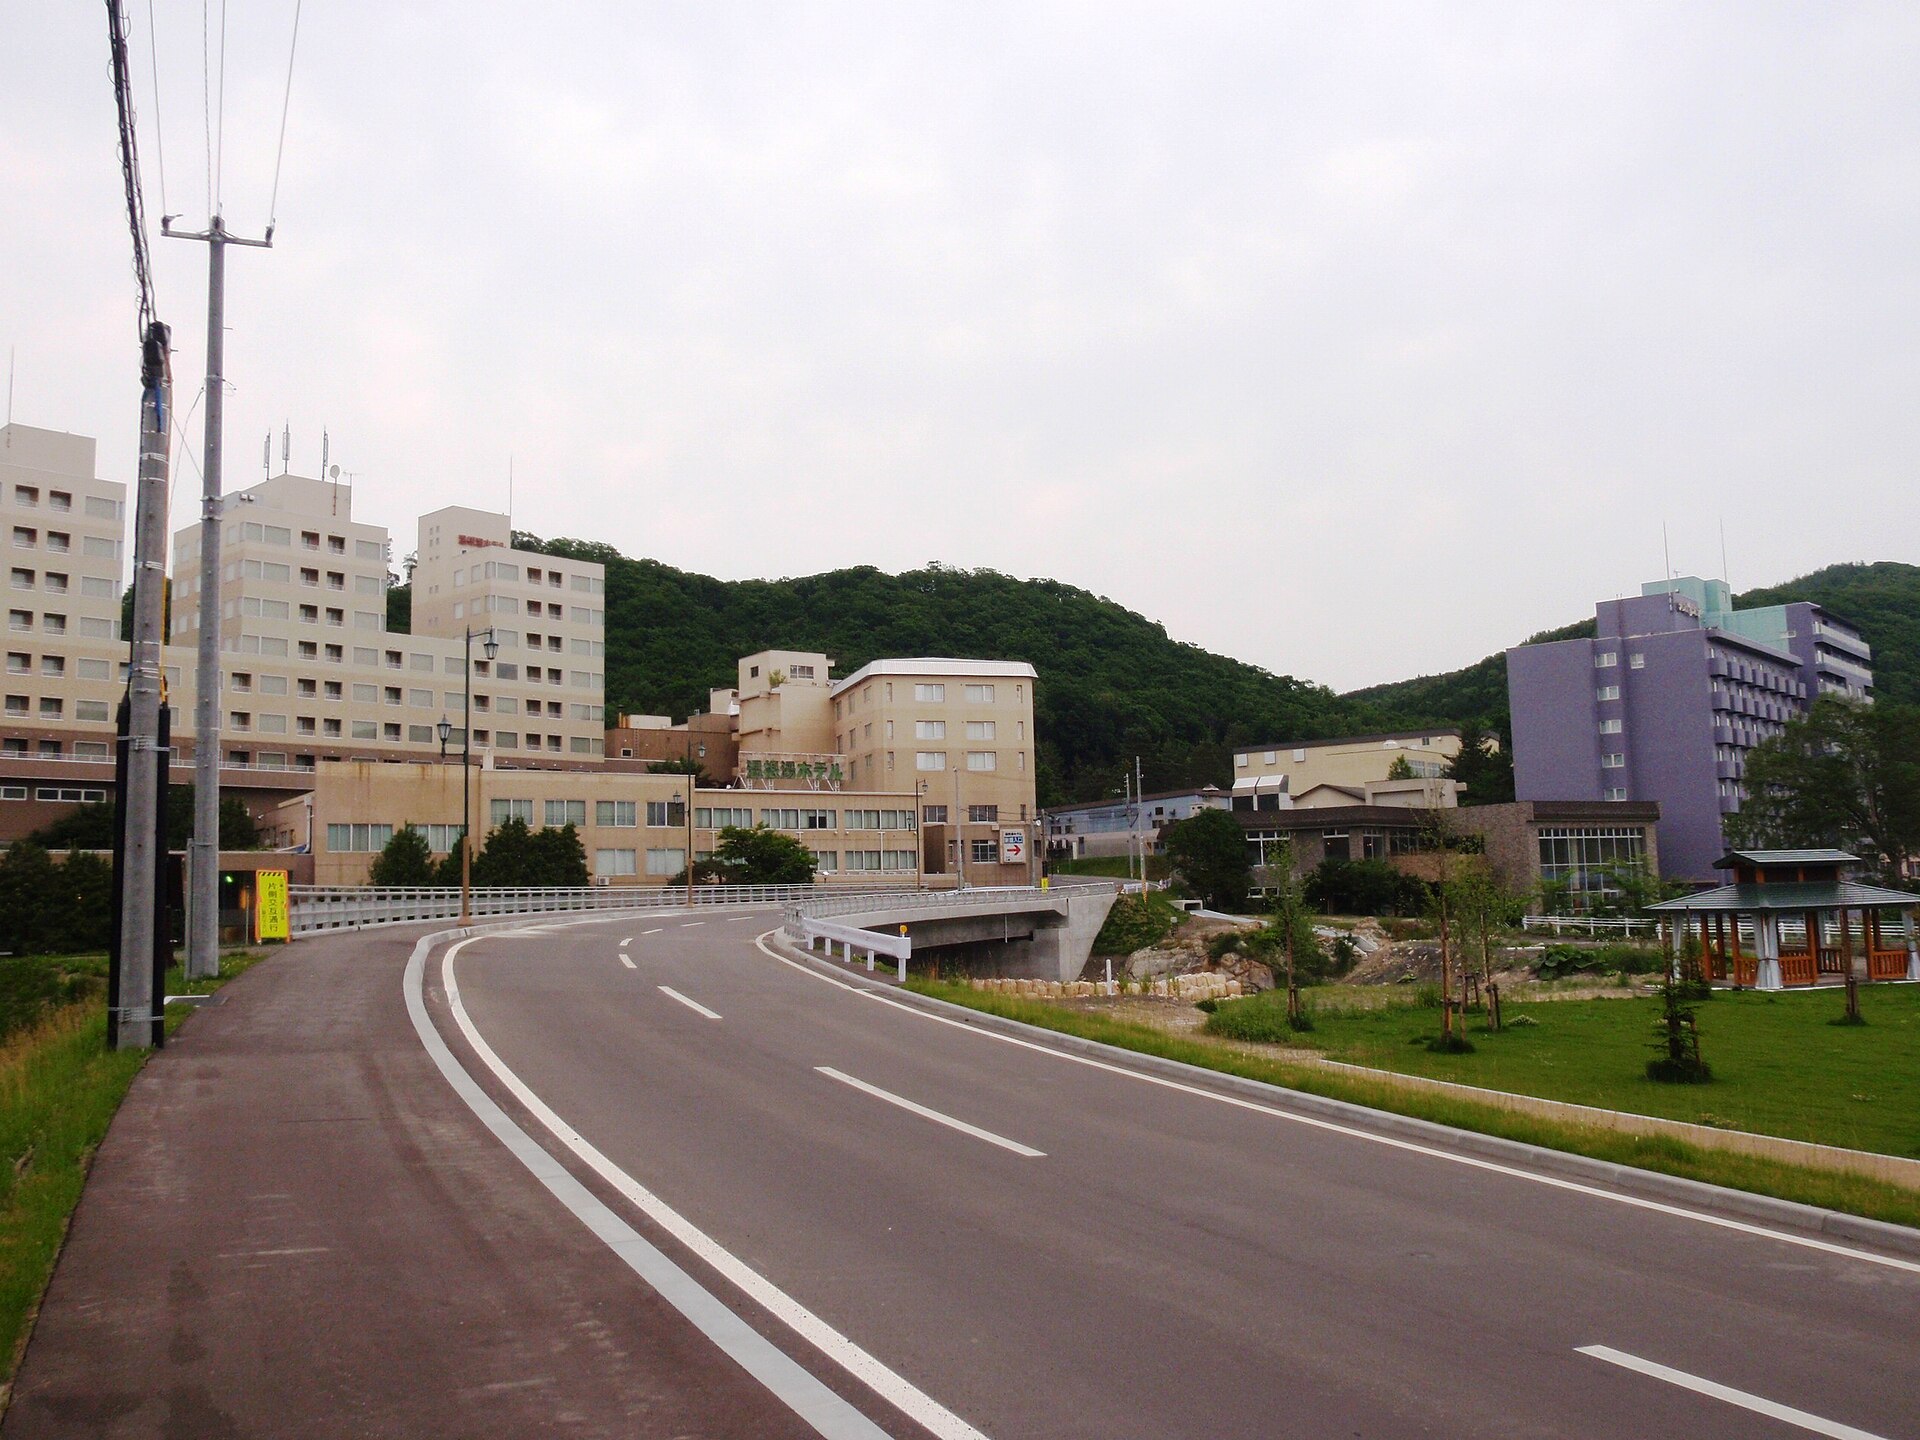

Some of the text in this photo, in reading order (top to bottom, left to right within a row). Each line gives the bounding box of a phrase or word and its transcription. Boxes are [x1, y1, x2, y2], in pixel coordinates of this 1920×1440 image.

[267, 882, 279, 933] 片側交互通行
